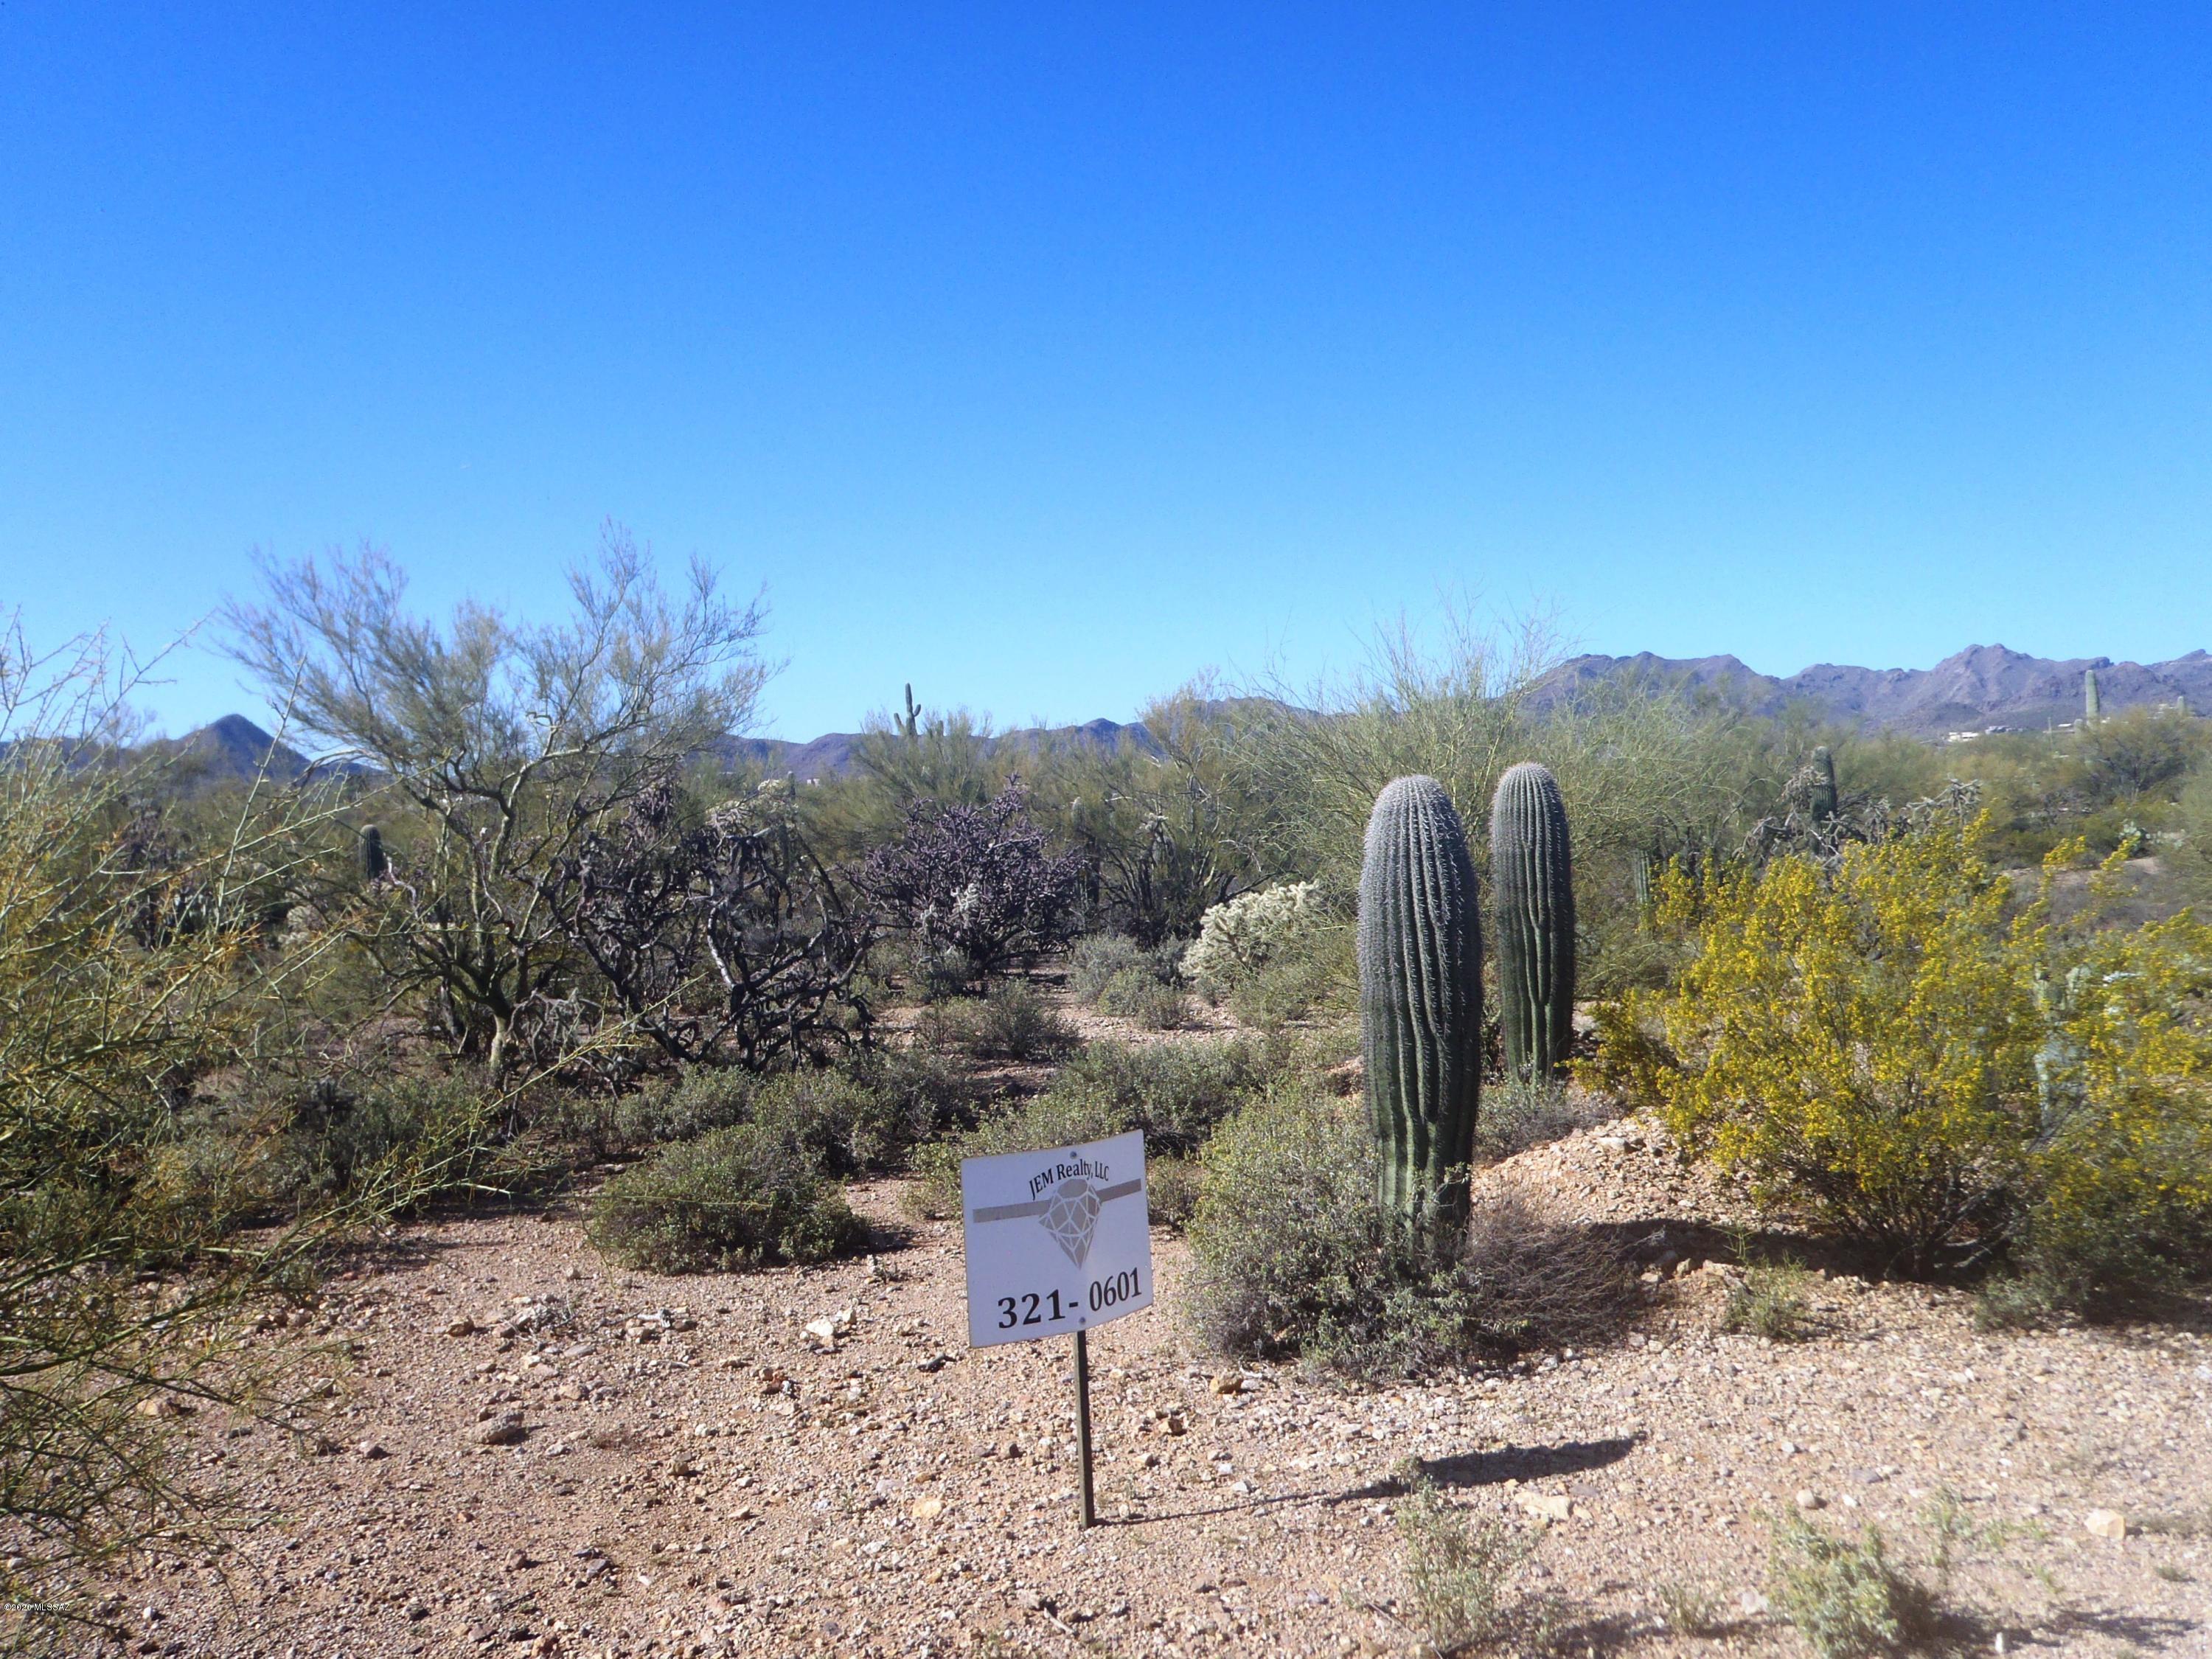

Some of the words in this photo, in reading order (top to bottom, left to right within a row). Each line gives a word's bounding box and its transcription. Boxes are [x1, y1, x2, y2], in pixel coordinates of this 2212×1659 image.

[1029, 1169, 1054, 1200] JEM
[1057, 1158, 1093, 1180] Realty,
[1094, 1161, 1110, 1181] LLC
